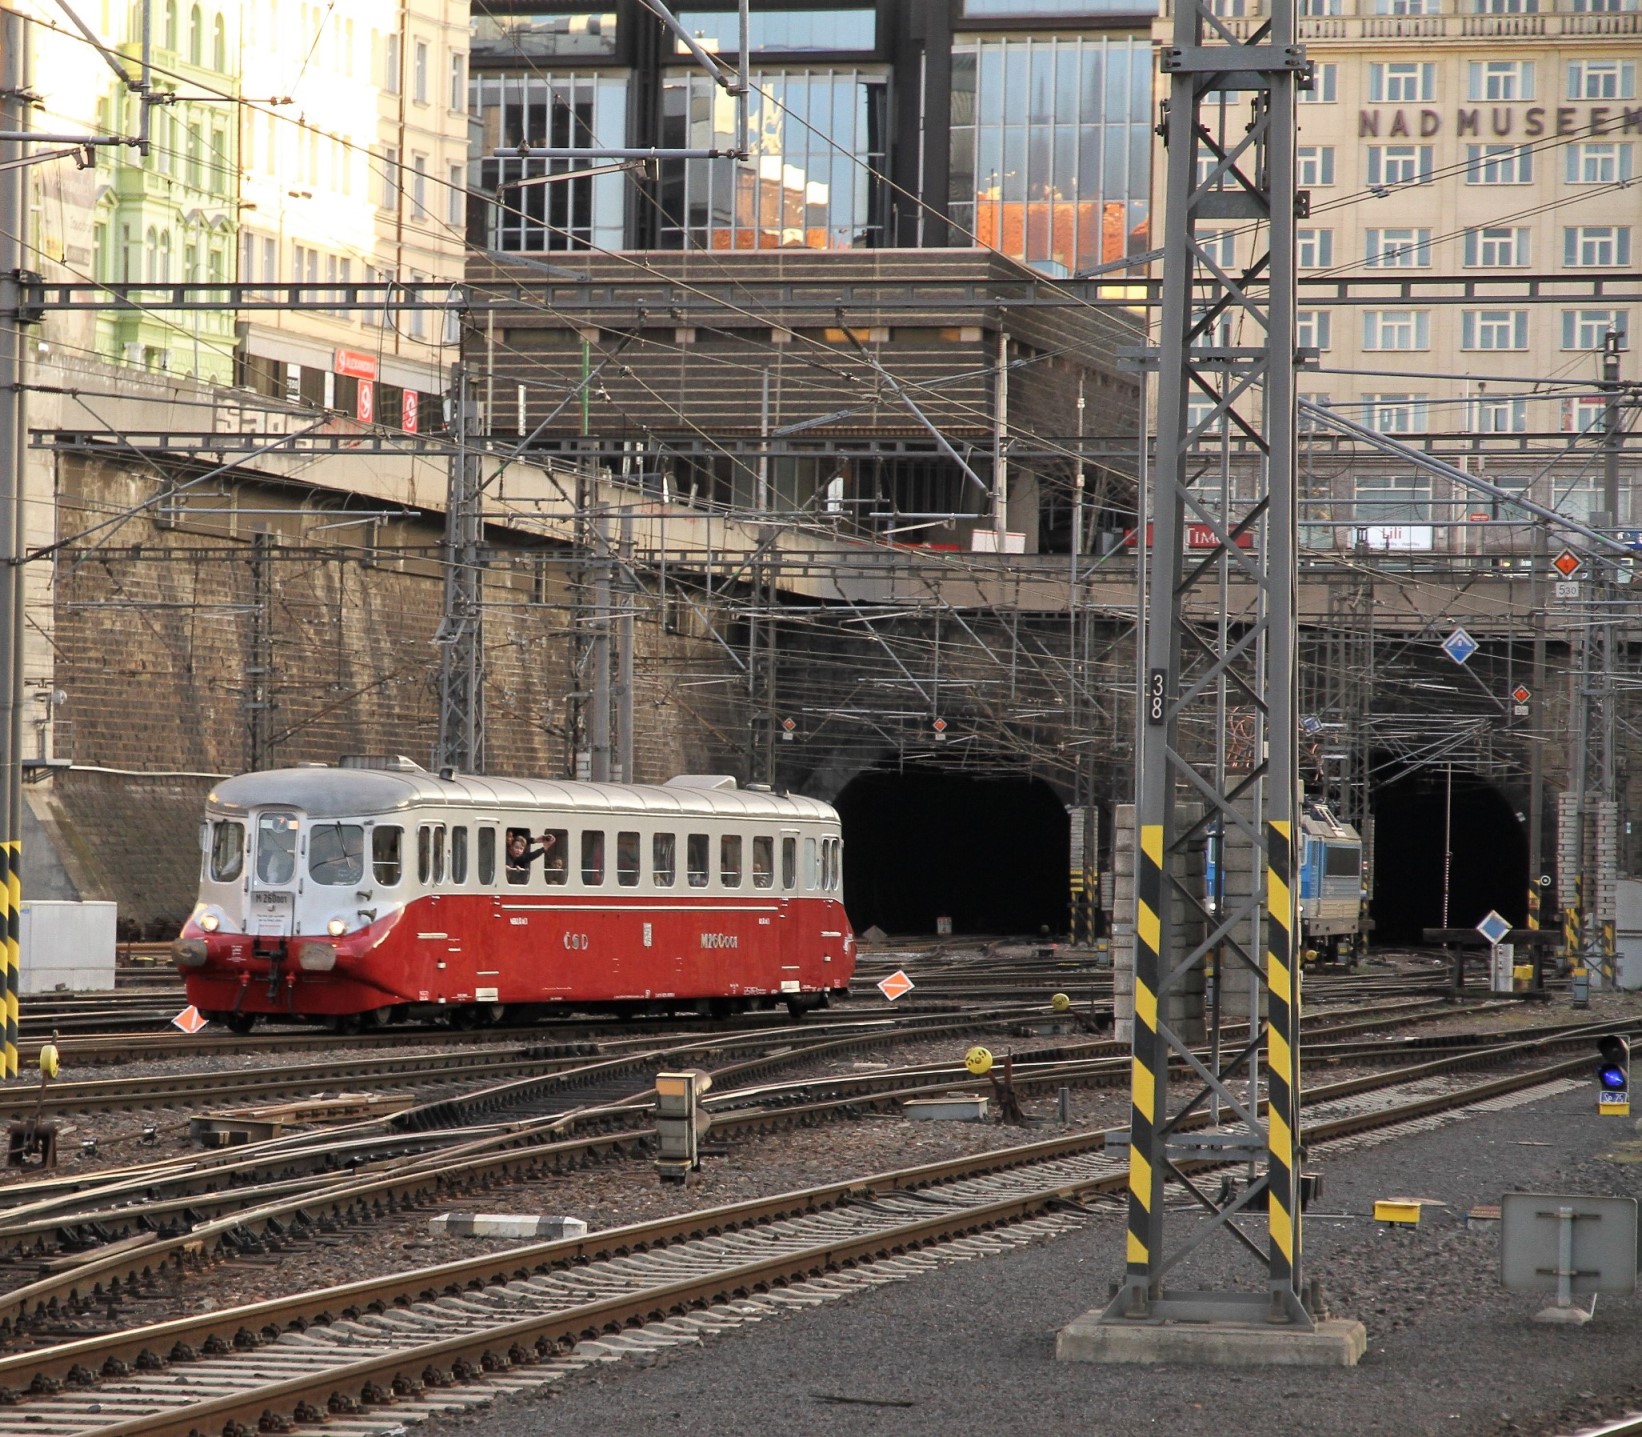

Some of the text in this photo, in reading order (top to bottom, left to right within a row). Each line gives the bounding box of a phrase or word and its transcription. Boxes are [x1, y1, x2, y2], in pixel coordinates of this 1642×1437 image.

[1359, 109, 1441, 137] NAD
[1382, 526, 1402, 539] Lili
[1559, 584, 1577, 595] 530
[1152, 674, 1163, 719] 38
[563, 931, 588, 950] ČSD
